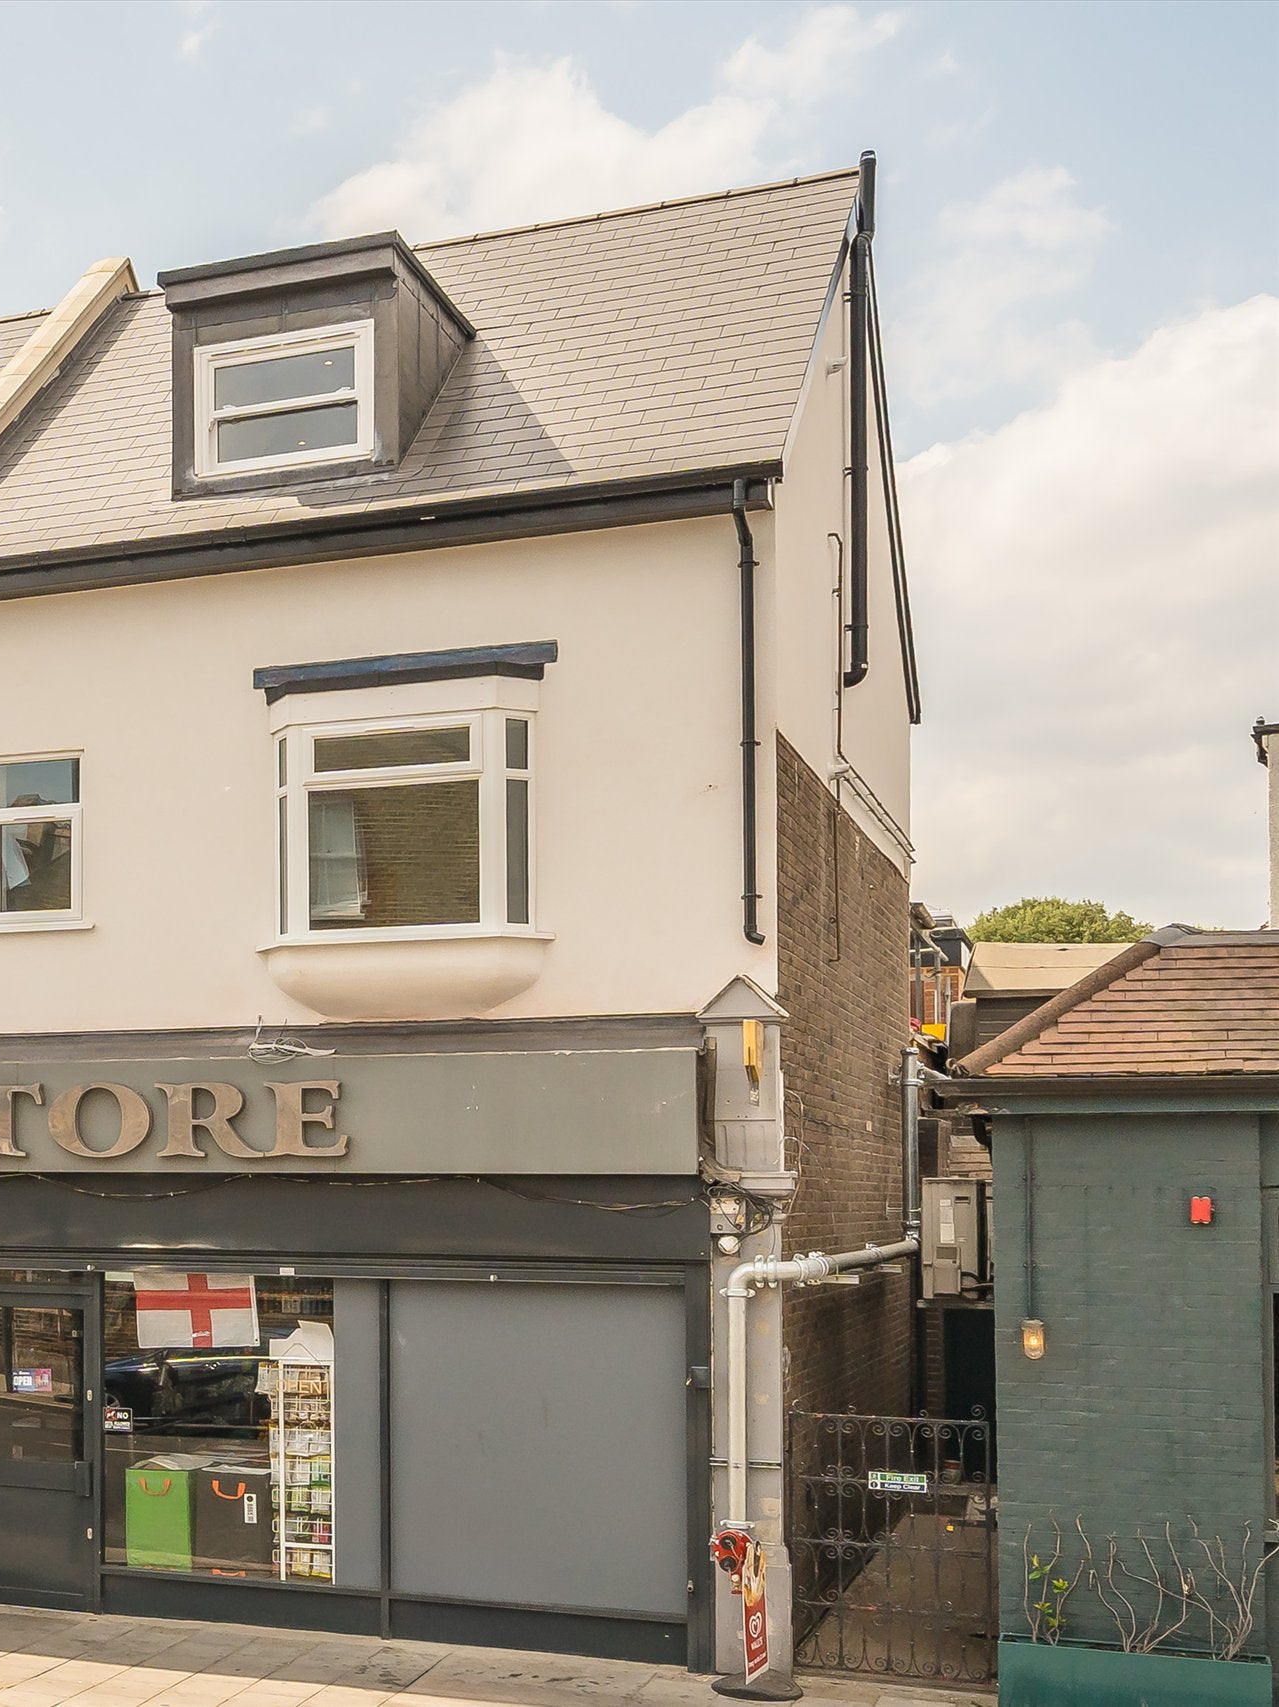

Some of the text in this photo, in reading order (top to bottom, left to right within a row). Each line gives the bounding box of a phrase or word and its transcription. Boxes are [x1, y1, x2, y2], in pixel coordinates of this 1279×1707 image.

[13, 1375, 33, 1386] OPEN
[275, 1379, 322, 1394] OPEN
[116, 1411, 129, 1419] NO
[886, 1474, 919, 1483] Fire Exit
